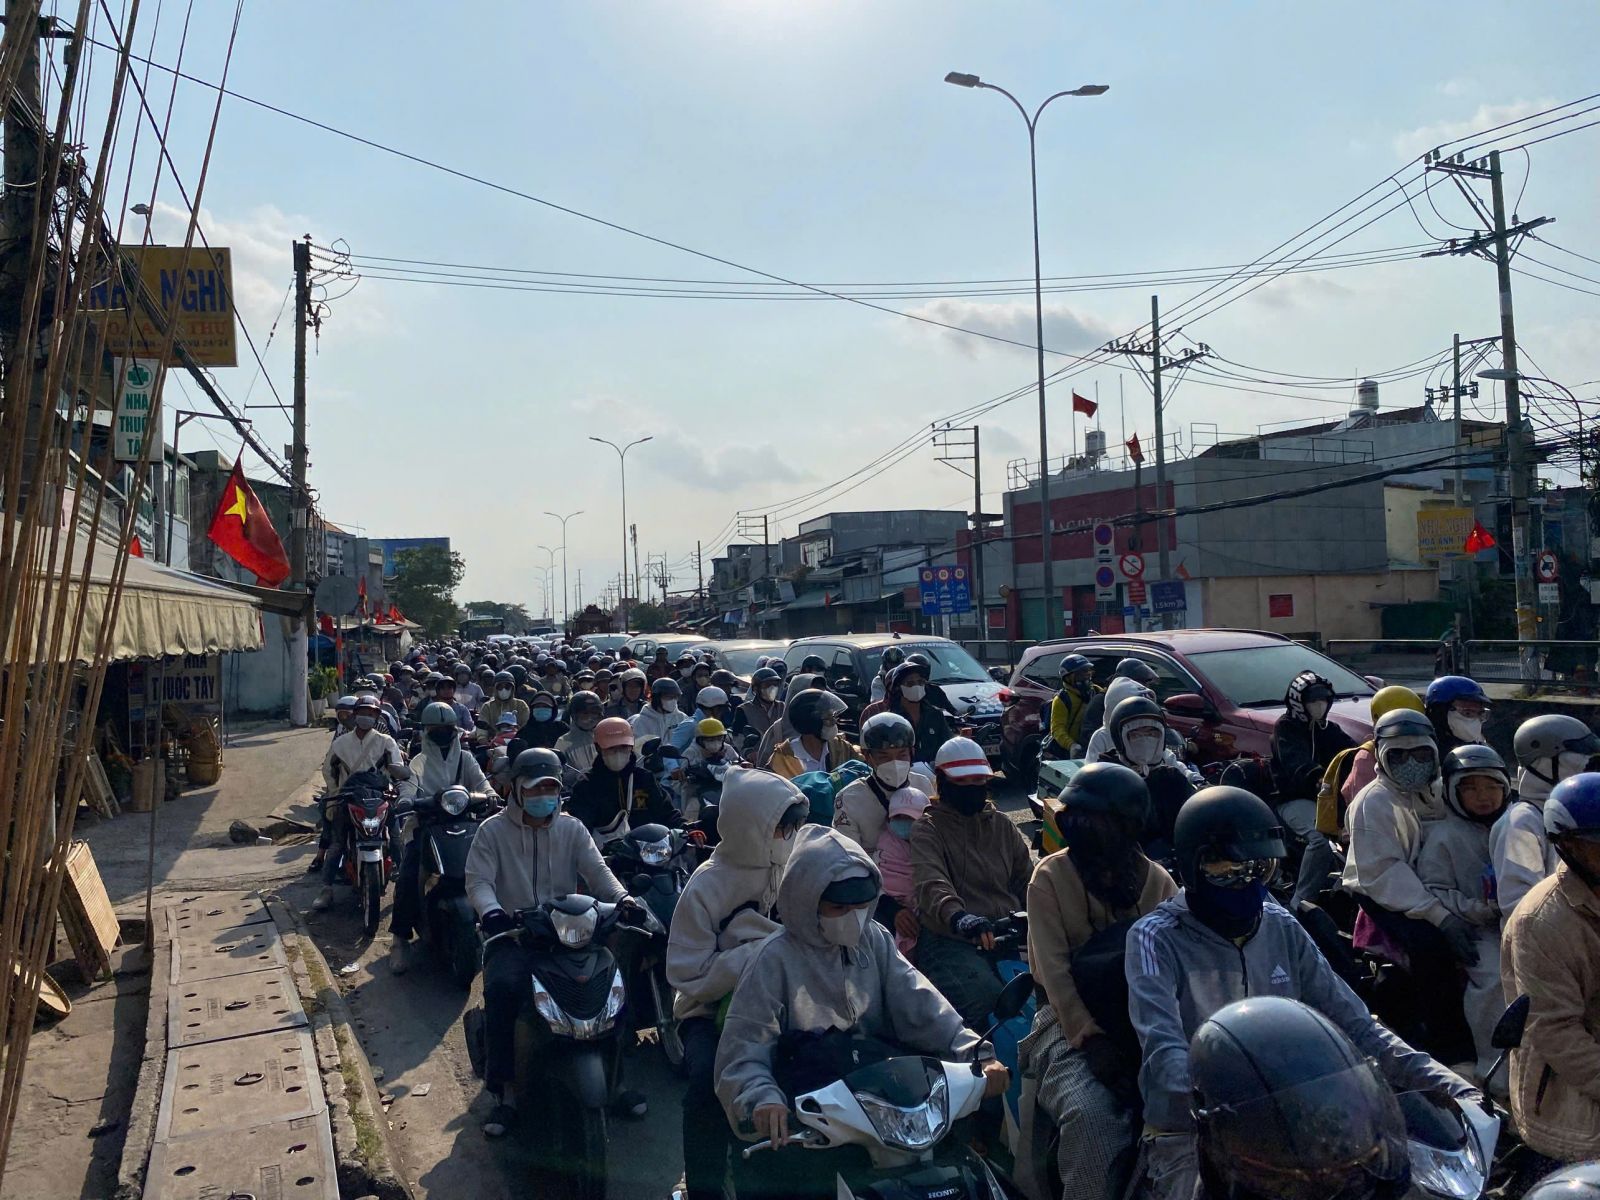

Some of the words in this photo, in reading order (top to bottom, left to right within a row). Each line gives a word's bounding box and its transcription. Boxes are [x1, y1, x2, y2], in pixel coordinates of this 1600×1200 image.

[126, 391, 149, 410] NHÀ
[126, 436, 143, 455] TÂ
[927, 1187, 960, 1199] HONDA
